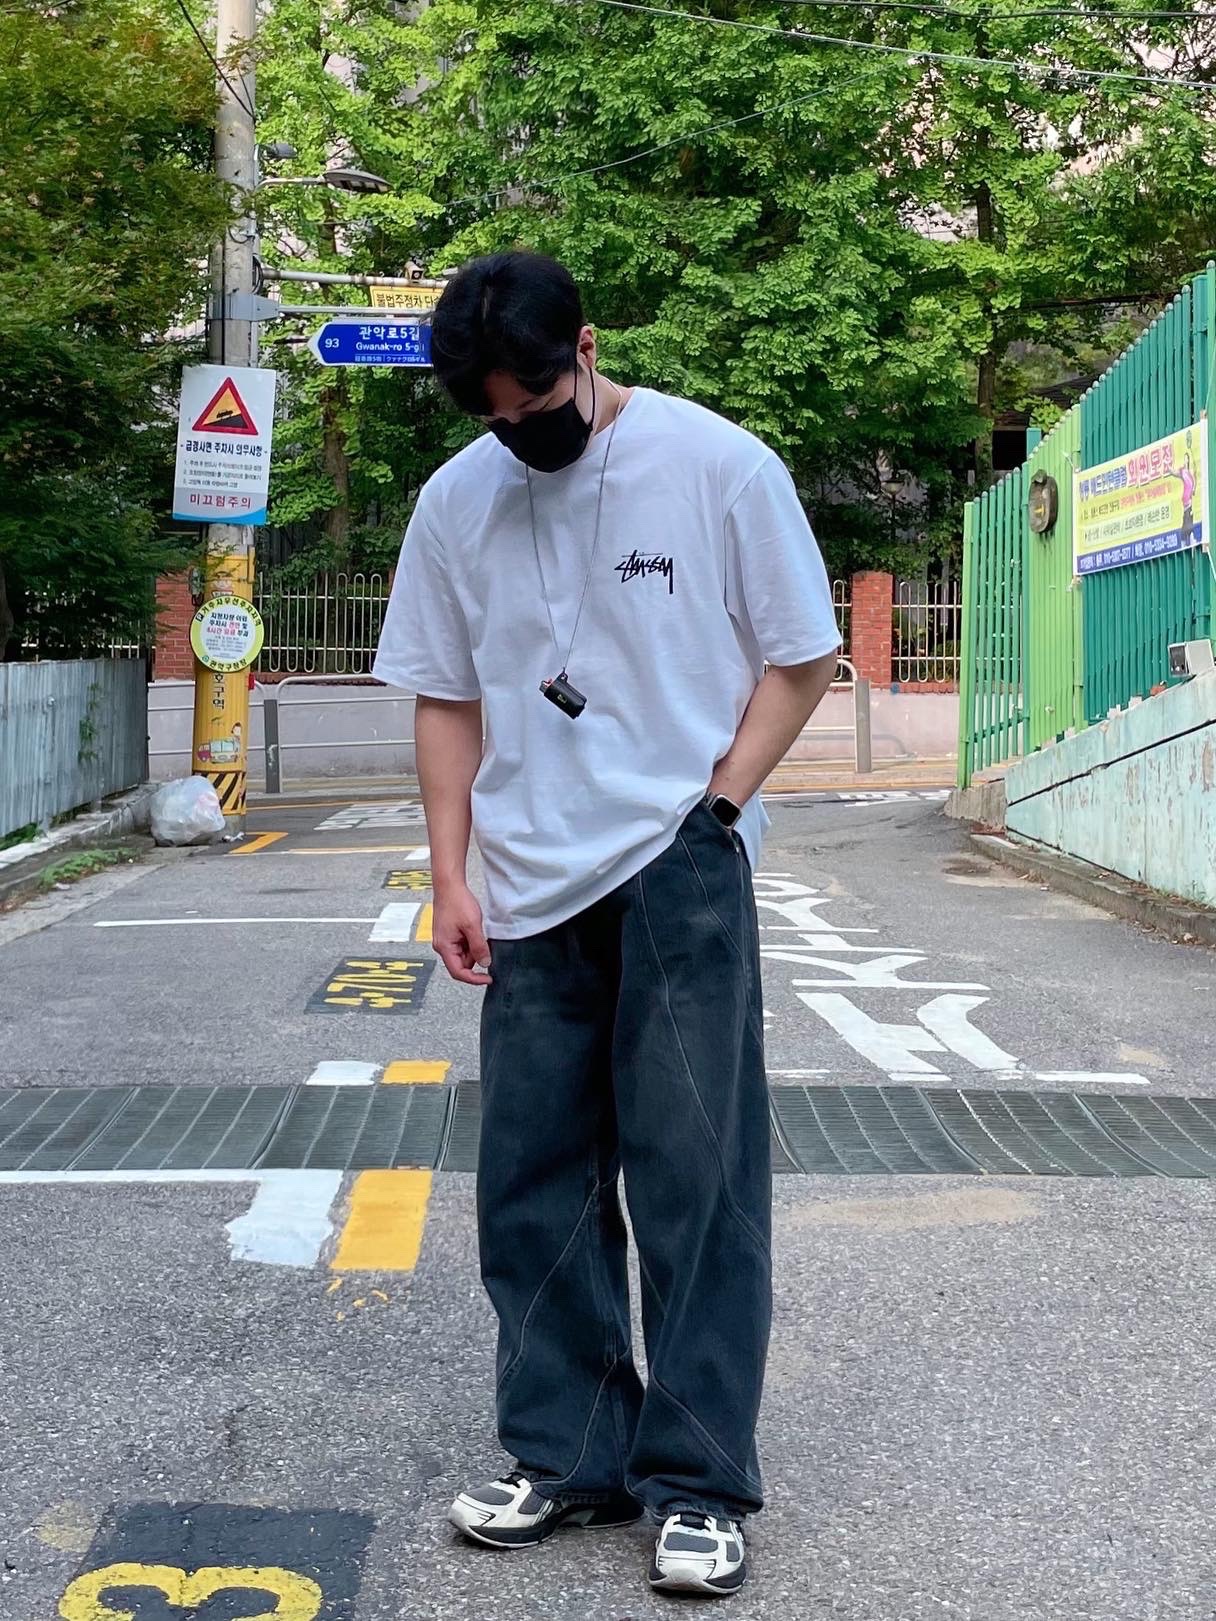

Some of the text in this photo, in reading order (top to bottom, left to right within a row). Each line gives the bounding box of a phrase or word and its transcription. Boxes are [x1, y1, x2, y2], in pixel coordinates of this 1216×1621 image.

[376, 293, 422, 308] 불법주정차
[359, 326, 419, 341] 관악로5길
[325, 338, 340, 348] 93
[355, 342, 402, 351] Gwanak-ro
[214, 442, 234, 454] 주차시
[236, 444, 262, 457] 의무사항
[1128, 442, 1173, 486] 회원모집
[190, 493, 251, 509] 미끄럼주의
